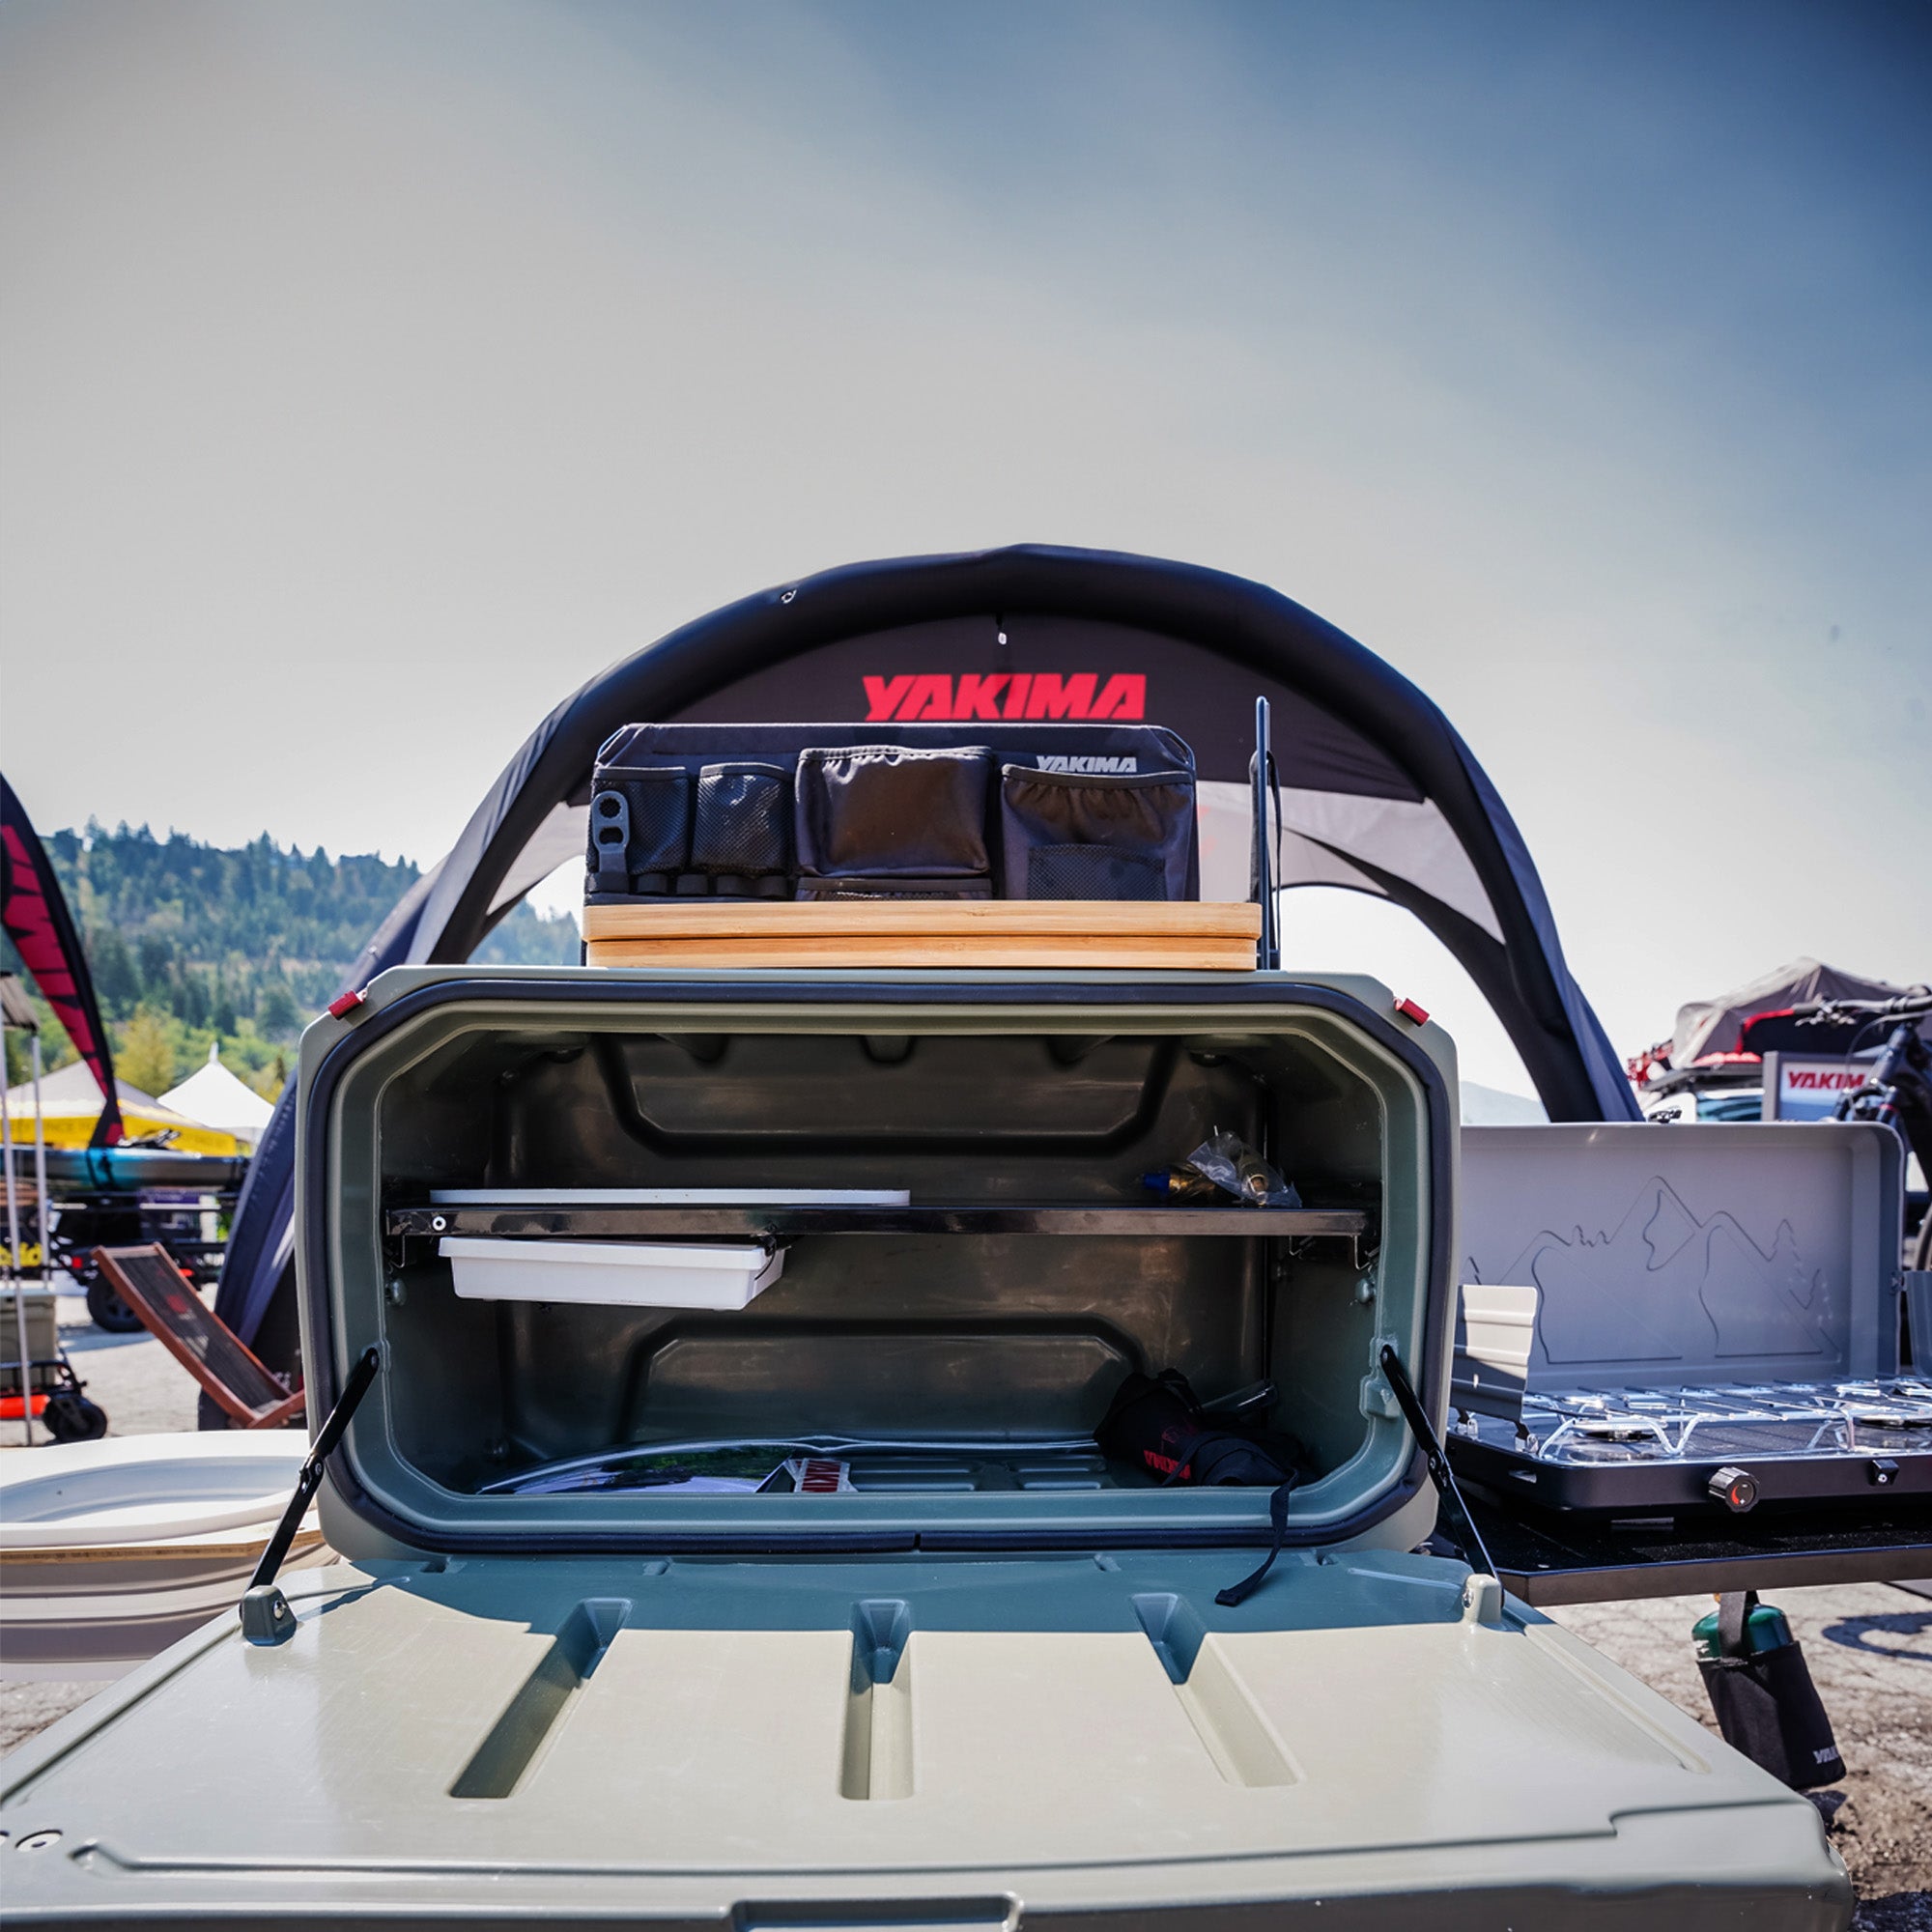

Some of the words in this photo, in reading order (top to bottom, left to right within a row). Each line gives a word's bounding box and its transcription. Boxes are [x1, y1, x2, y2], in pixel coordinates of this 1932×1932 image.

[863, 673, 1146, 722] YAKIMA
[1037, 755, 1137, 773] YAKIMA
[1788, 1071, 1865, 1089] YAKIM
